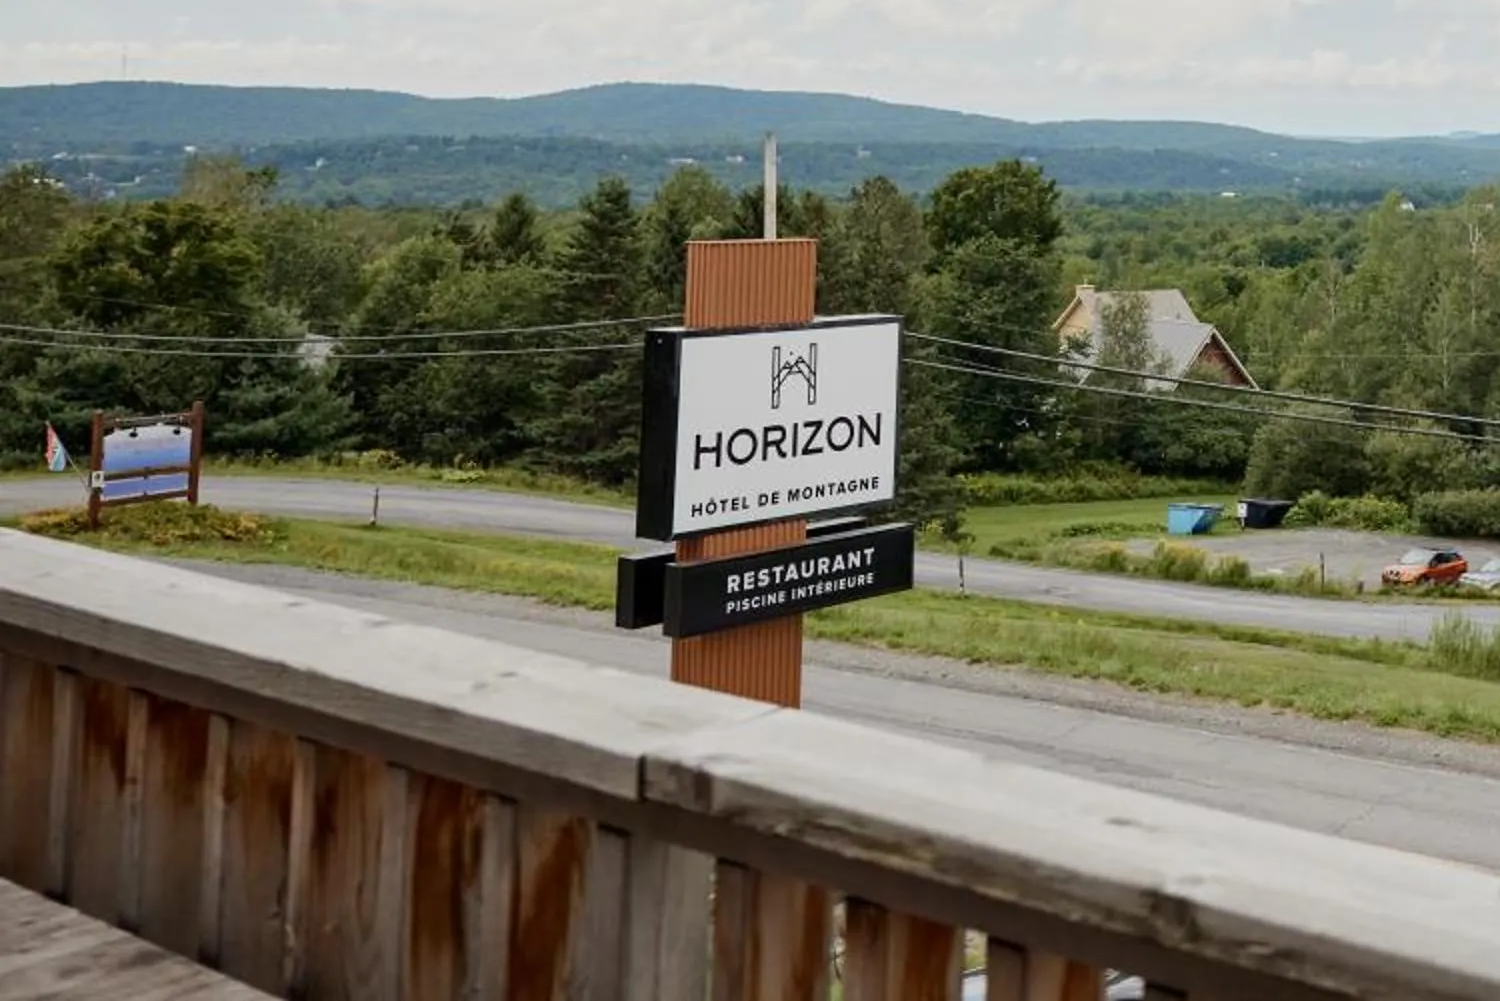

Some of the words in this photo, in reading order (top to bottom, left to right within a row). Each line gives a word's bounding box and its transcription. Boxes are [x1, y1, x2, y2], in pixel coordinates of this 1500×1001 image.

[693, 412, 881, 470] HORIZON
[690, 495, 750, 517] HÔTEL
[757, 490, 780, 507] DE
[787, 476, 879, 502] MONTAGNE
[727, 547, 875, 593] RESTAURANT
[726, 591, 786, 613] PISCINE
[791, 572, 875, 600] INTÉRIEURE
